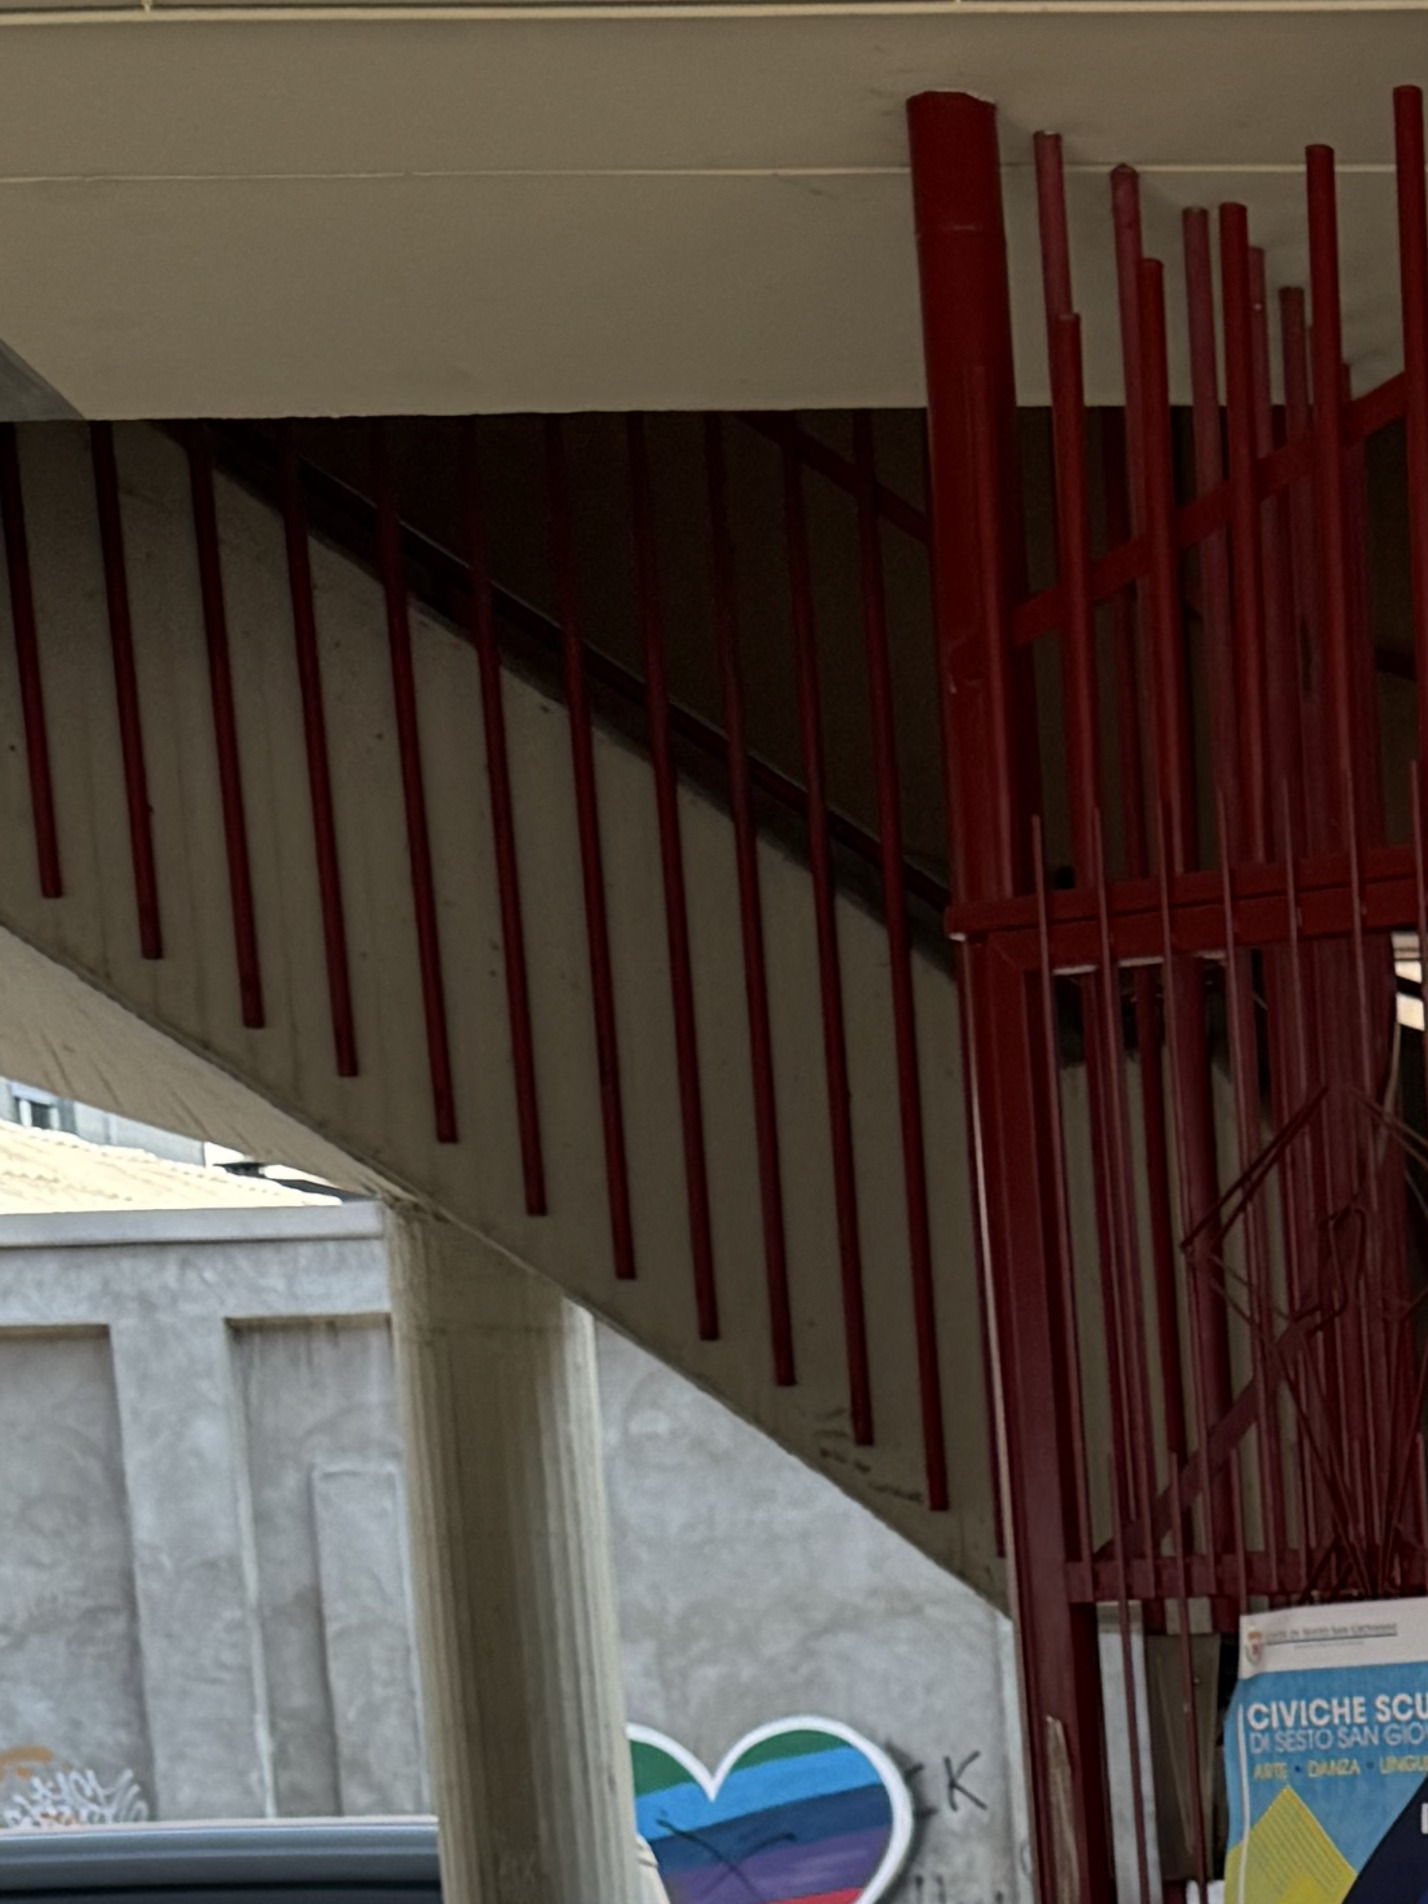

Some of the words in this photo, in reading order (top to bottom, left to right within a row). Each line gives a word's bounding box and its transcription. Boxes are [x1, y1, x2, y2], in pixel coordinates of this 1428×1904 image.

[1247, 1696, 1365, 1730] CIVICHE
[1249, 1730, 1270, 1755] DI
[1274, 1728, 1334, 1753] SESTO
[1337, 1725, 1380, 1748] SAN
